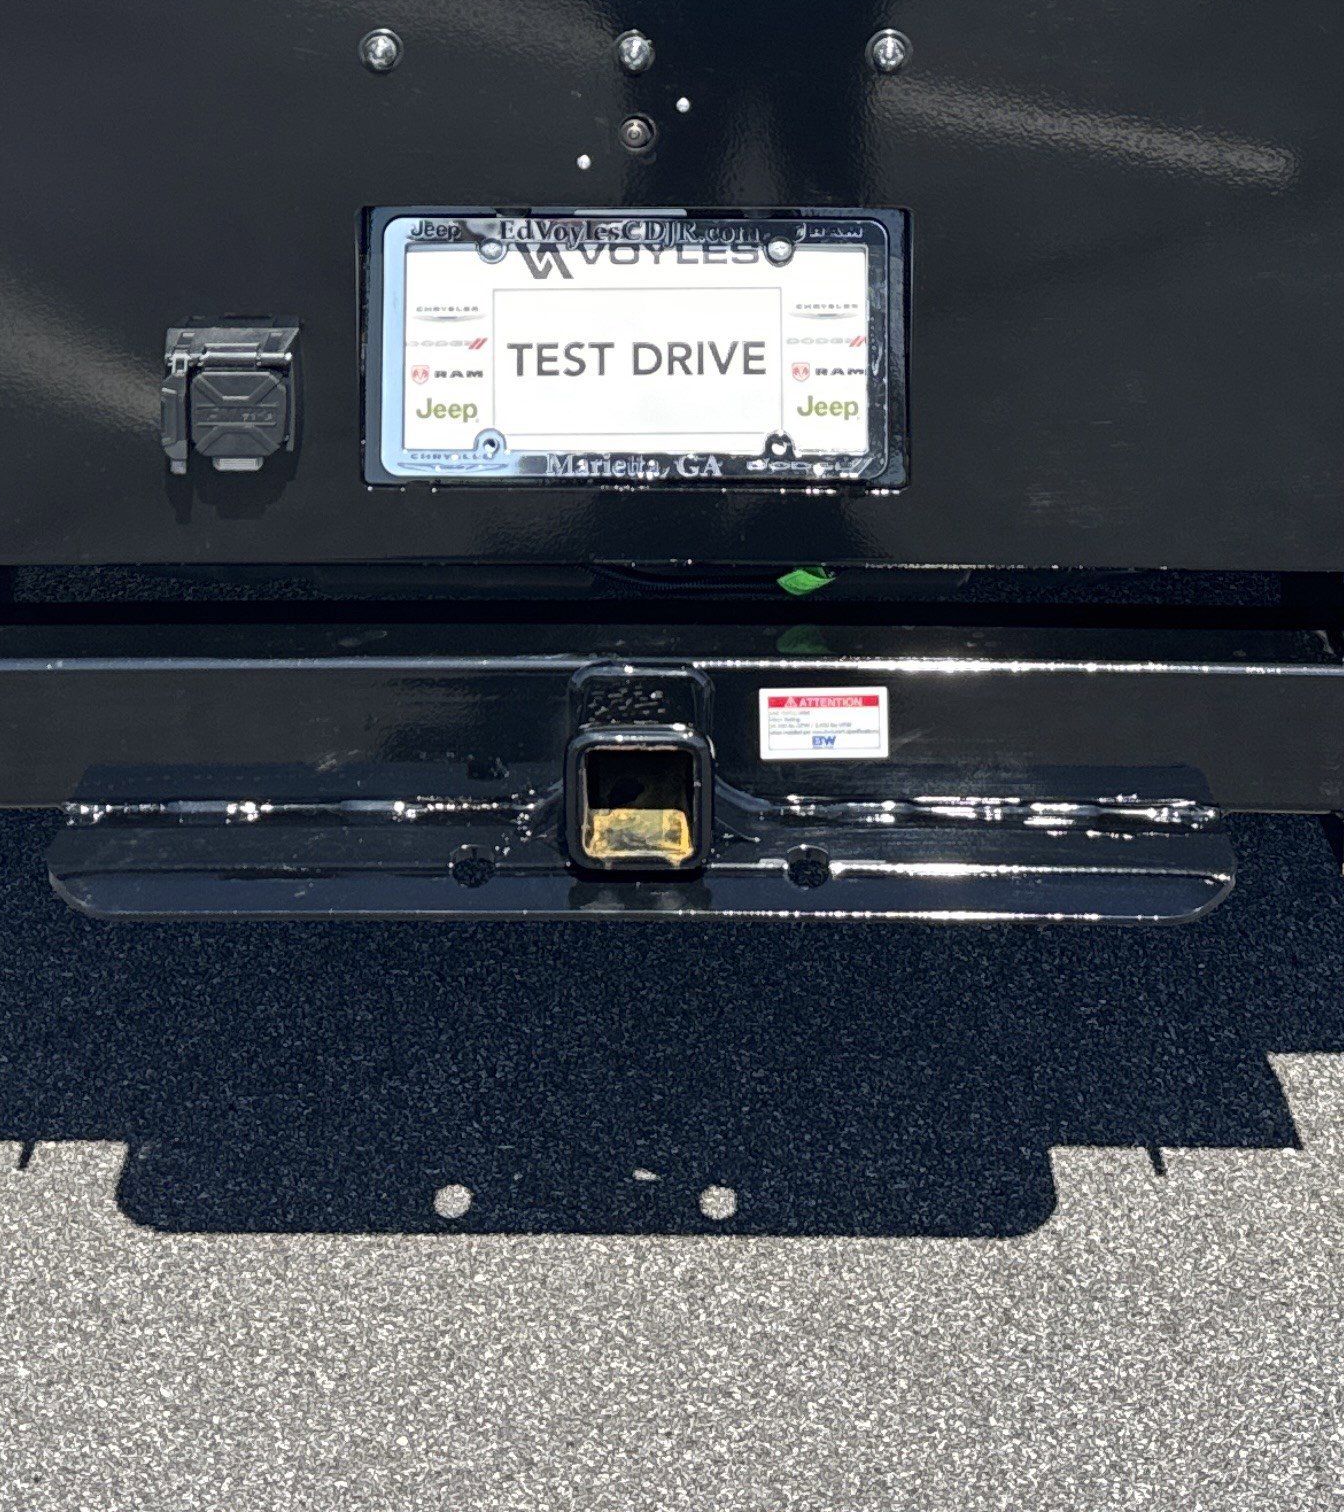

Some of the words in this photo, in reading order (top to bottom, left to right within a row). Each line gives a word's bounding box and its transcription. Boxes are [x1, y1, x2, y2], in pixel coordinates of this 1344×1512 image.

[410, 220, 462, 241] Jeep
[500, 219, 760, 249] EdVoylesCDJR.com
[578, 242, 759, 265] VOYLES
[506, 342, 615, 377] TEST
[632, 341, 767, 376] DRIVE
[434, 370, 484, 378] RAM
[815, 368, 867, 376] RAM
[416, 397, 478, 423] Jeep
[797, 395, 859, 420] Jeep
[674, 454, 723, 477] GA
[799, 697, 863, 708] ATTENTION
